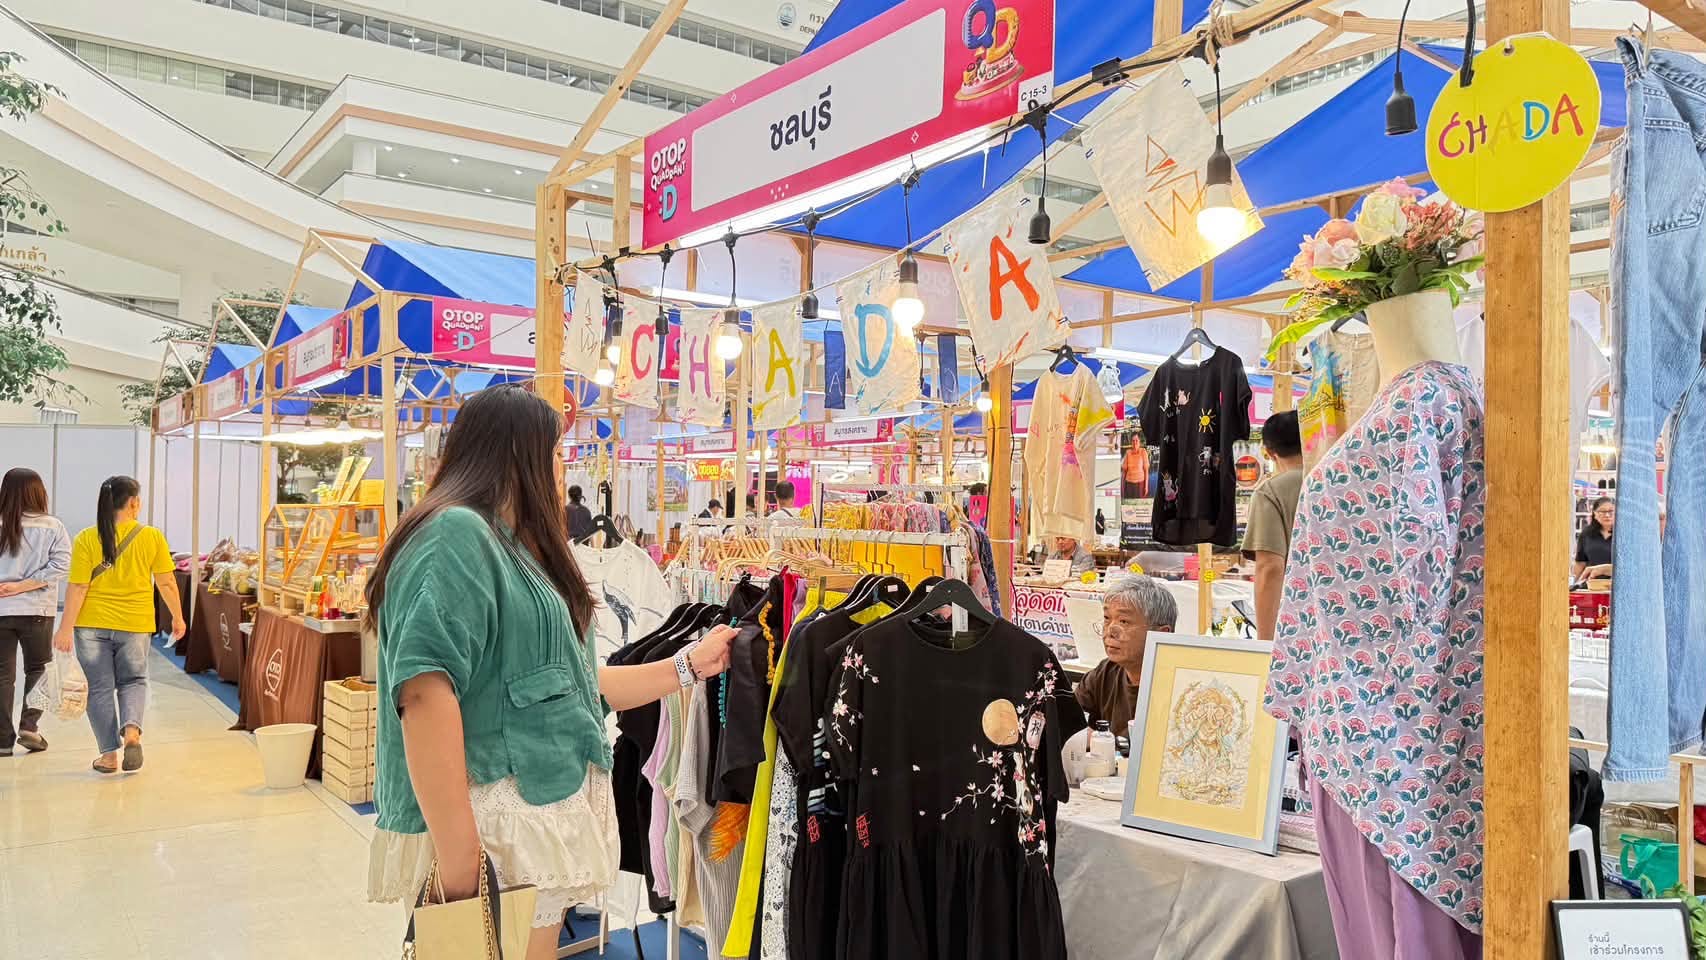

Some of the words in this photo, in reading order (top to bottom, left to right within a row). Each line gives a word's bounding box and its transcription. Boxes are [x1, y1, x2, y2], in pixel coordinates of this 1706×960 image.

[769, 84, 832, 151] ชลบุรี
[1438, 93, 1584, 158] CHADA
[650, 137, 687, 174] OTOP
[650, 160, 687, 192] QUADRANT
[442, 309, 485, 324] OTOP
[442, 320, 485, 332] QUADRANT
[1588, 931, 1610, 943] ร้านนี้
[1589, 944, 1665, 956] เข้าร่วมโครงการ
